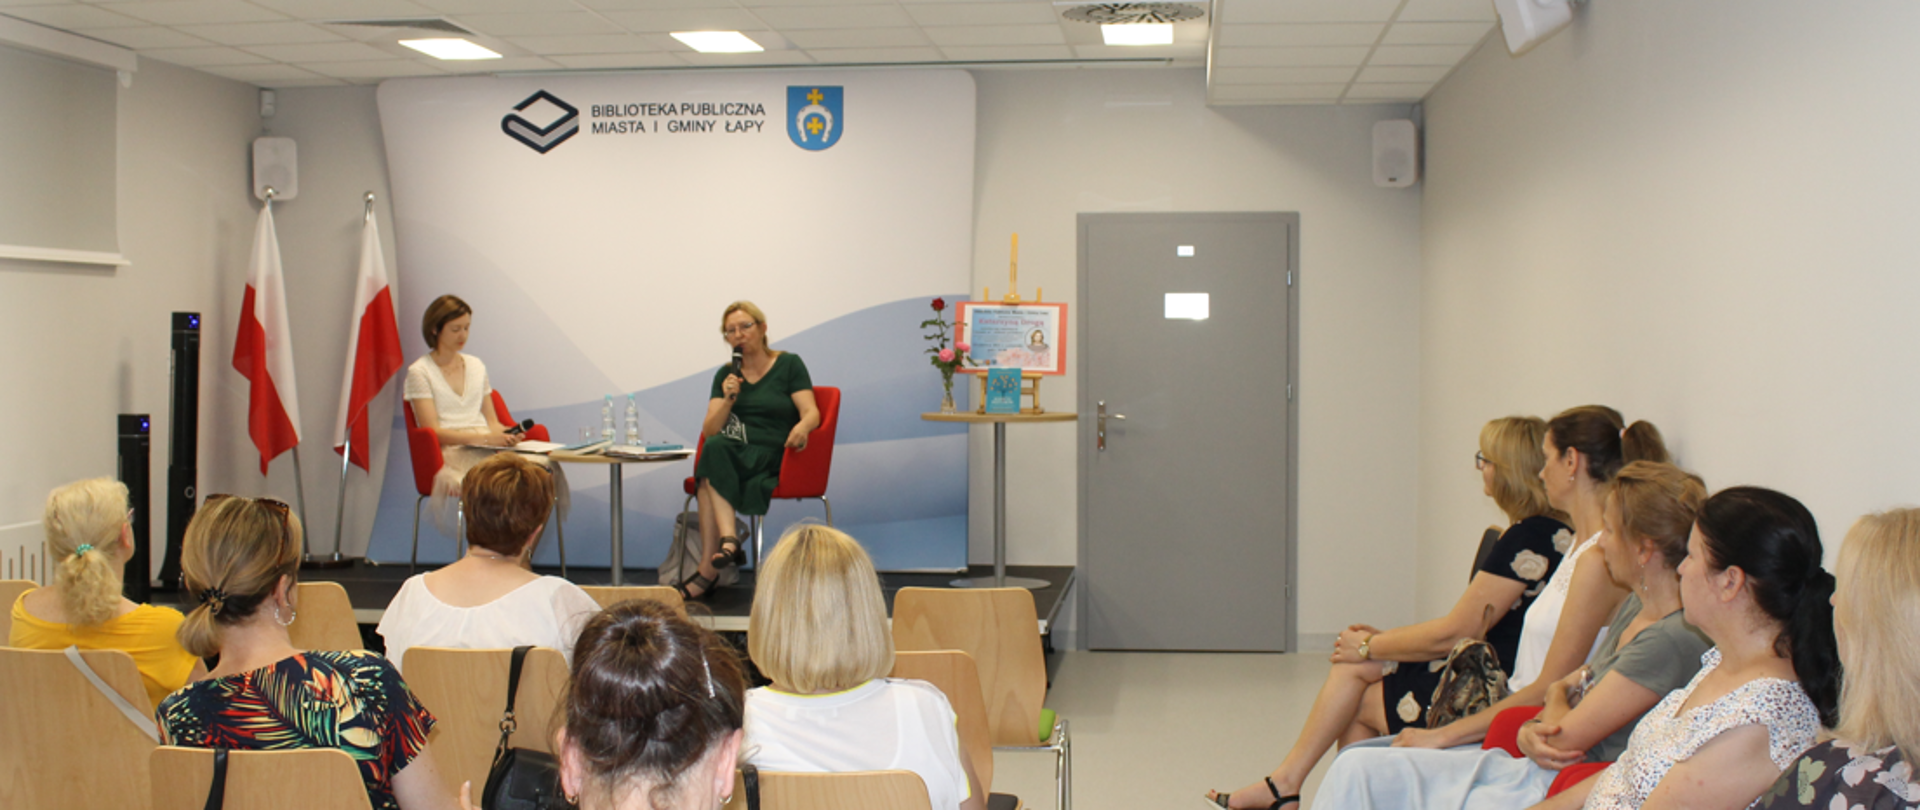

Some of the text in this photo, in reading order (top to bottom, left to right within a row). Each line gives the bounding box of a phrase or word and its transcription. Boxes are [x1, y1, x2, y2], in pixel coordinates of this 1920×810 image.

[591, 103, 766, 117] BIBLIOTEKA PUBLICZNA
[591, 120, 765, 134] MIASTA I GMINY ŁAPY
